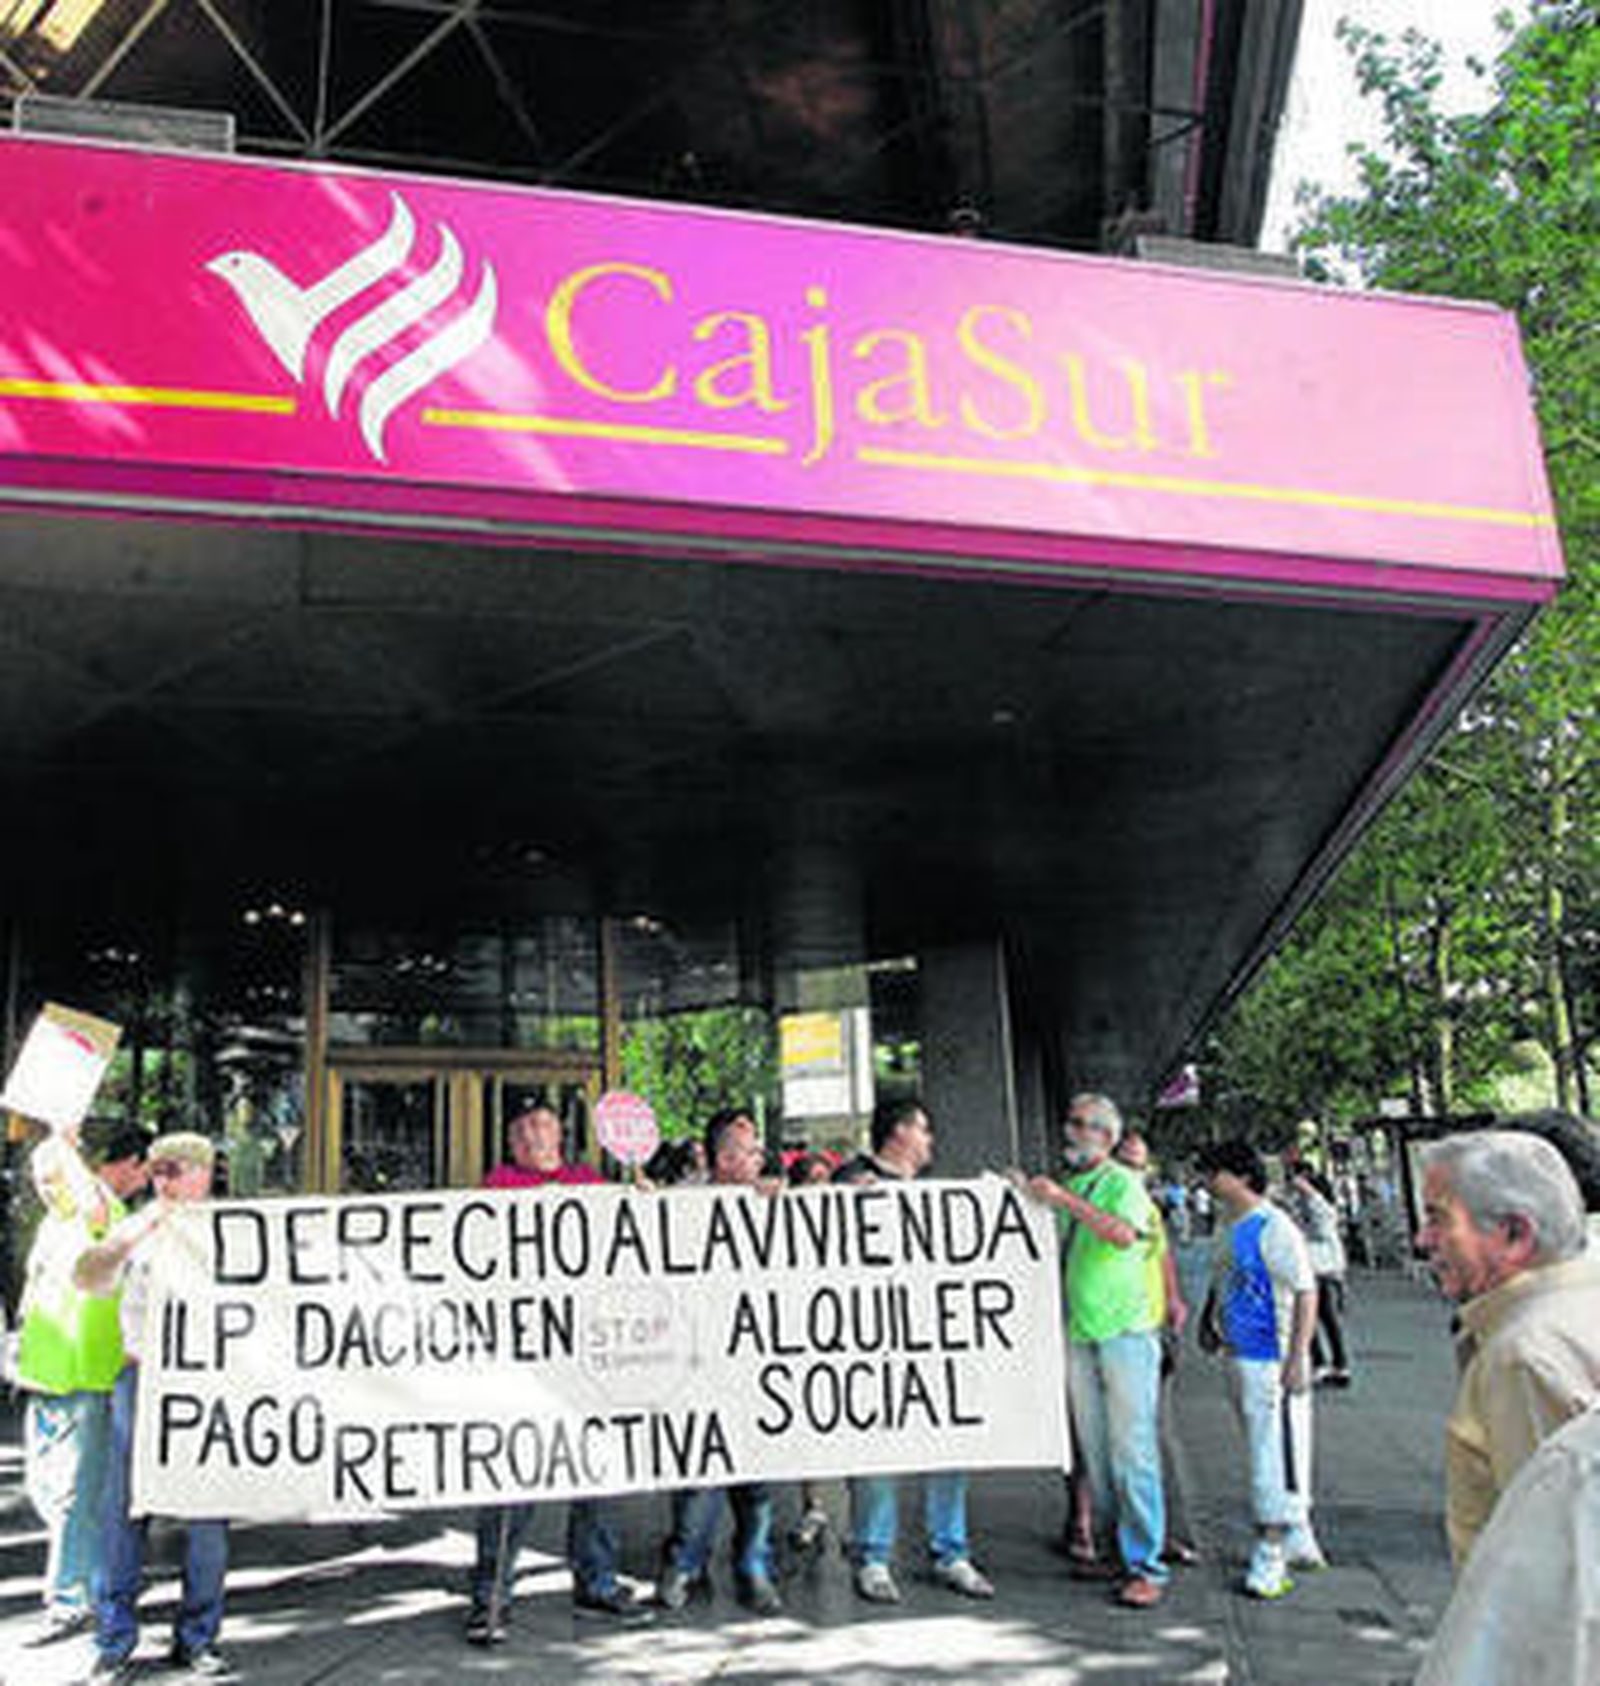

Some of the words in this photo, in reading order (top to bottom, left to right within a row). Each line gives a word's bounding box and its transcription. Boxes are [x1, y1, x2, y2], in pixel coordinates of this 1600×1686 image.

[546, 262, 1233, 466] CajaSur
[212, 1199, 590, 1286] DERECHO
[160, 1299, 256, 1371] ILP
[510, 1294, 574, 1362] EN
[727, 1278, 1015, 1357] ALQUILER
[158, 1394, 325, 1466] PAGO
[757, 1356, 984, 1436] SOCIAL
[333, 1410, 735, 1501] RETROACTIVA
